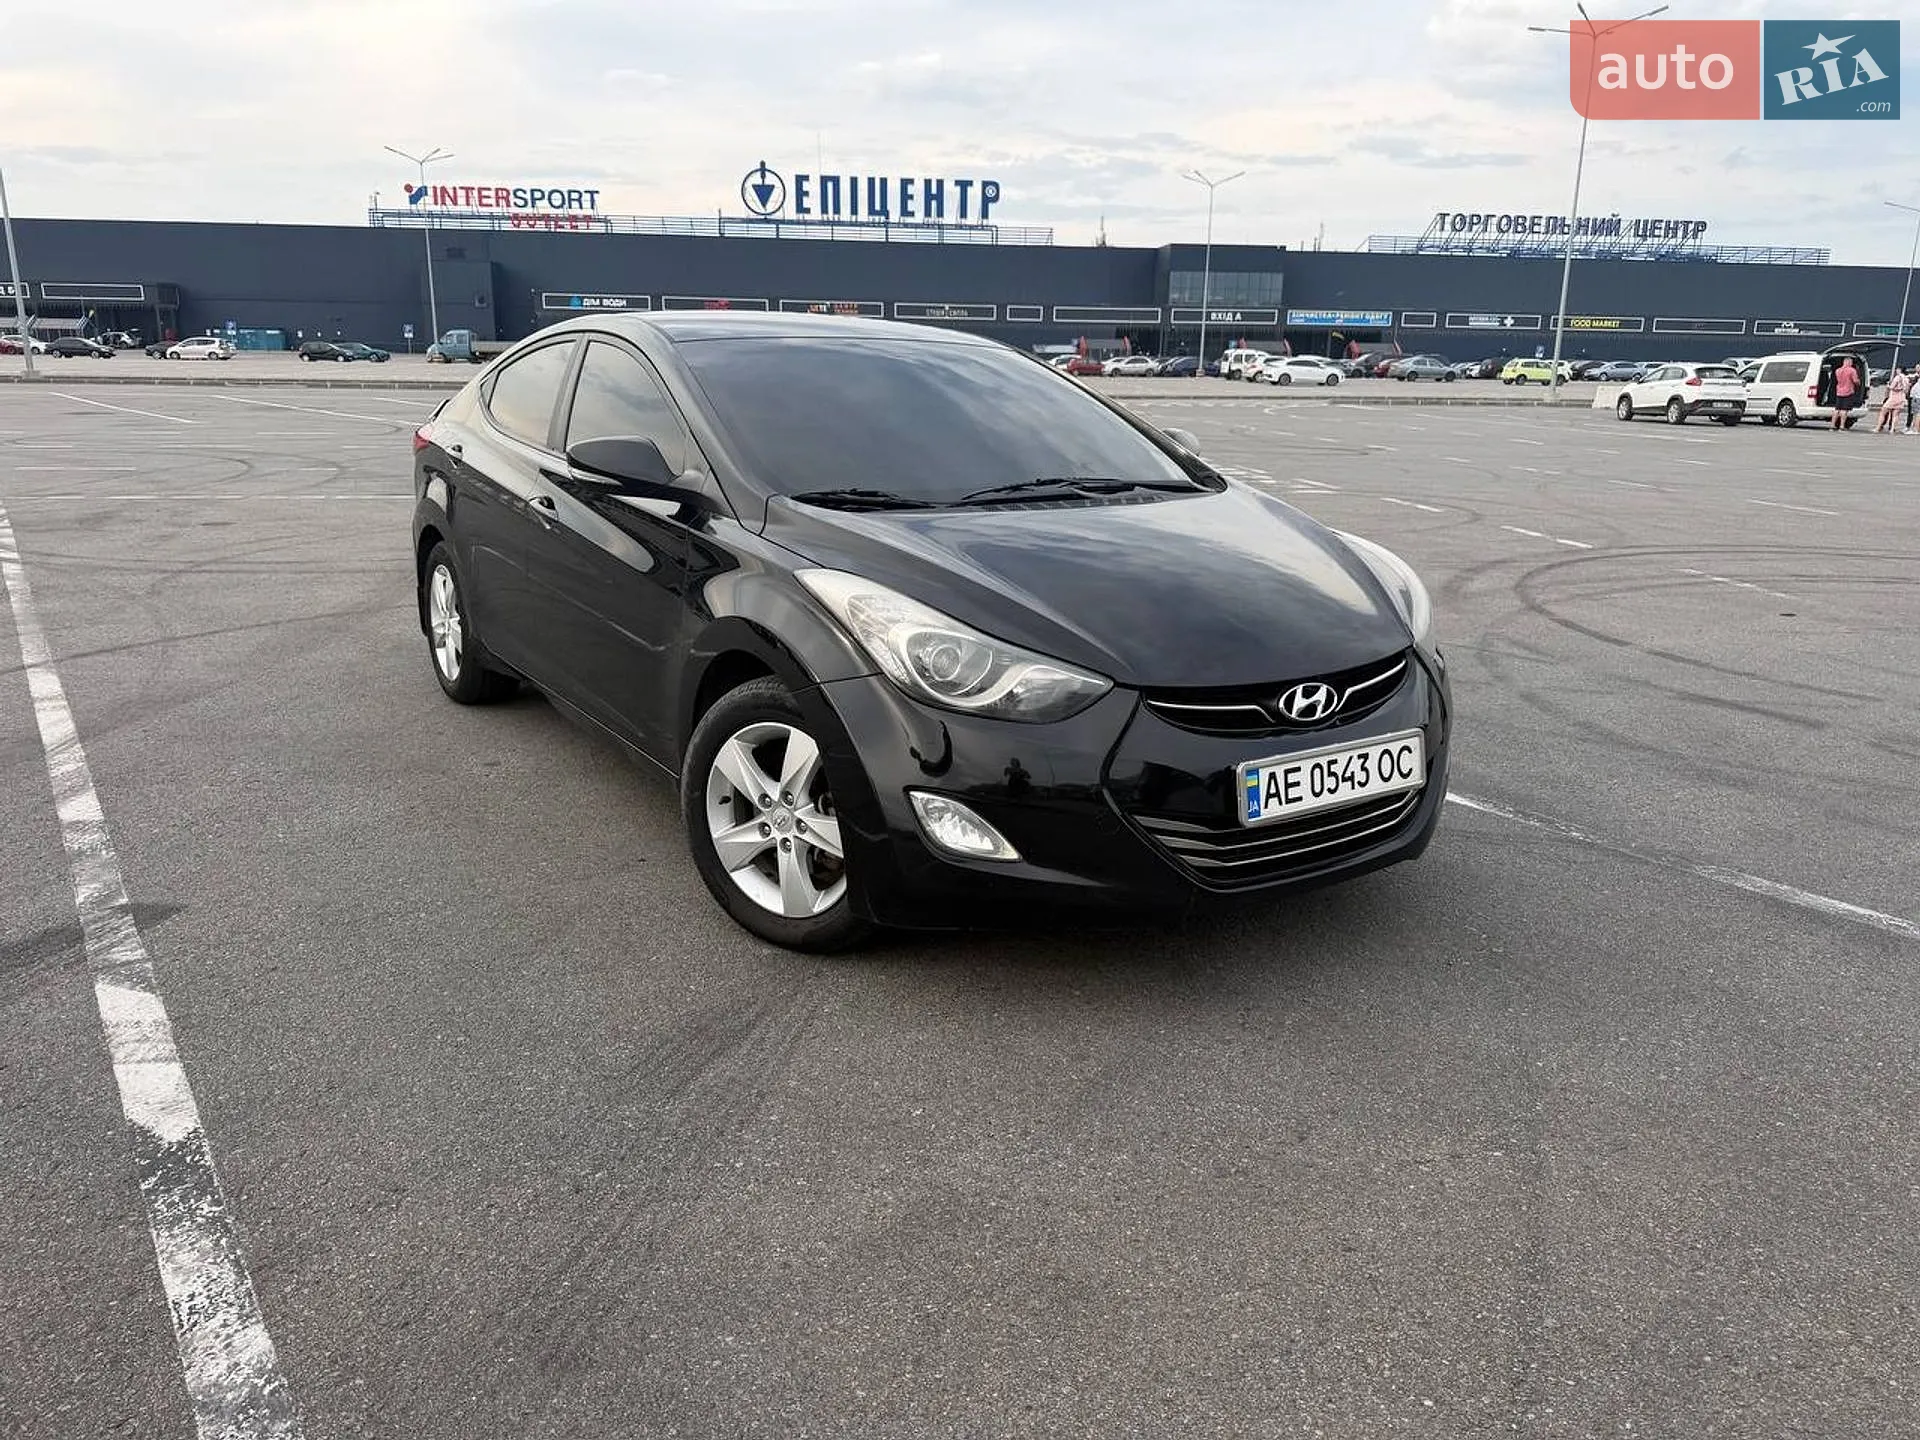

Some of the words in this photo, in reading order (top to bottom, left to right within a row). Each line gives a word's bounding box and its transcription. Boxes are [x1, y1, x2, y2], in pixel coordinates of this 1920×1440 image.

[432, 185, 600, 209] INTERSPORT
[795, 174, 1000, 220] ЕПІЦЕНТР
[1438, 212, 1622, 236] ТОРГОВЕЛЬНИЙ
[1634, 217, 1707, 240] ЦЕНТР
[1210, 312, 1233, 321] ВХІД
[1569, 319, 1591, 328] FOOD
[1592, 320, 1620, 329] MARKET
[1263, 765, 1303, 810] AE
[1309, 752, 1370, 798] 0543
[1377, 745, 1413, 783] OC
